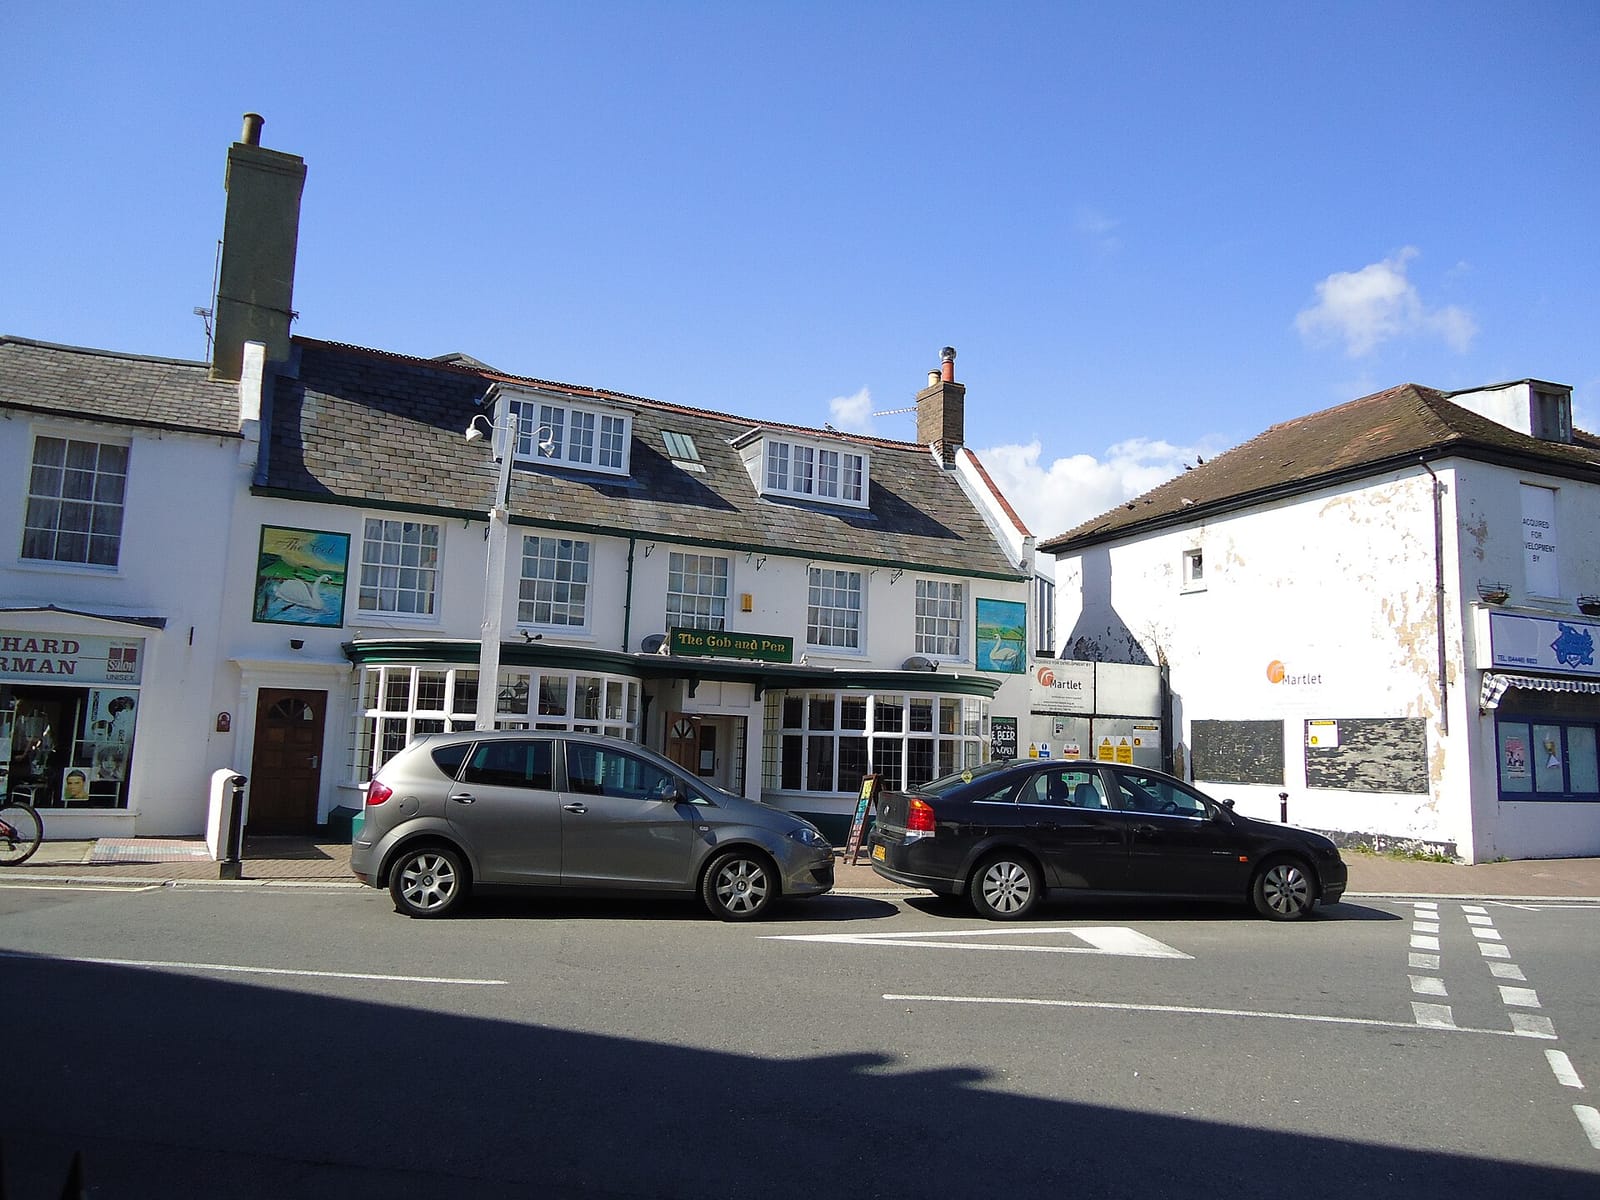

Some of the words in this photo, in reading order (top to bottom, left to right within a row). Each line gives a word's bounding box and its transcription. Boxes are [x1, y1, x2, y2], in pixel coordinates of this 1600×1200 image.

[1522, 518, 1550, 529] ACQUIRED
[1530, 531, 1543, 539] FOR
[1532, 554, 1540, 562] BY
[0, 636, 80, 654] HARD
[678, 633, 703, 646] The
[734, 639, 758, 650] and
[761, 640, 785, 653] Pen
[1050, 679, 1082, 690] Martlet
[1282, 673, 1322, 685] Martlet
[997, 730, 1015, 741] BEER
